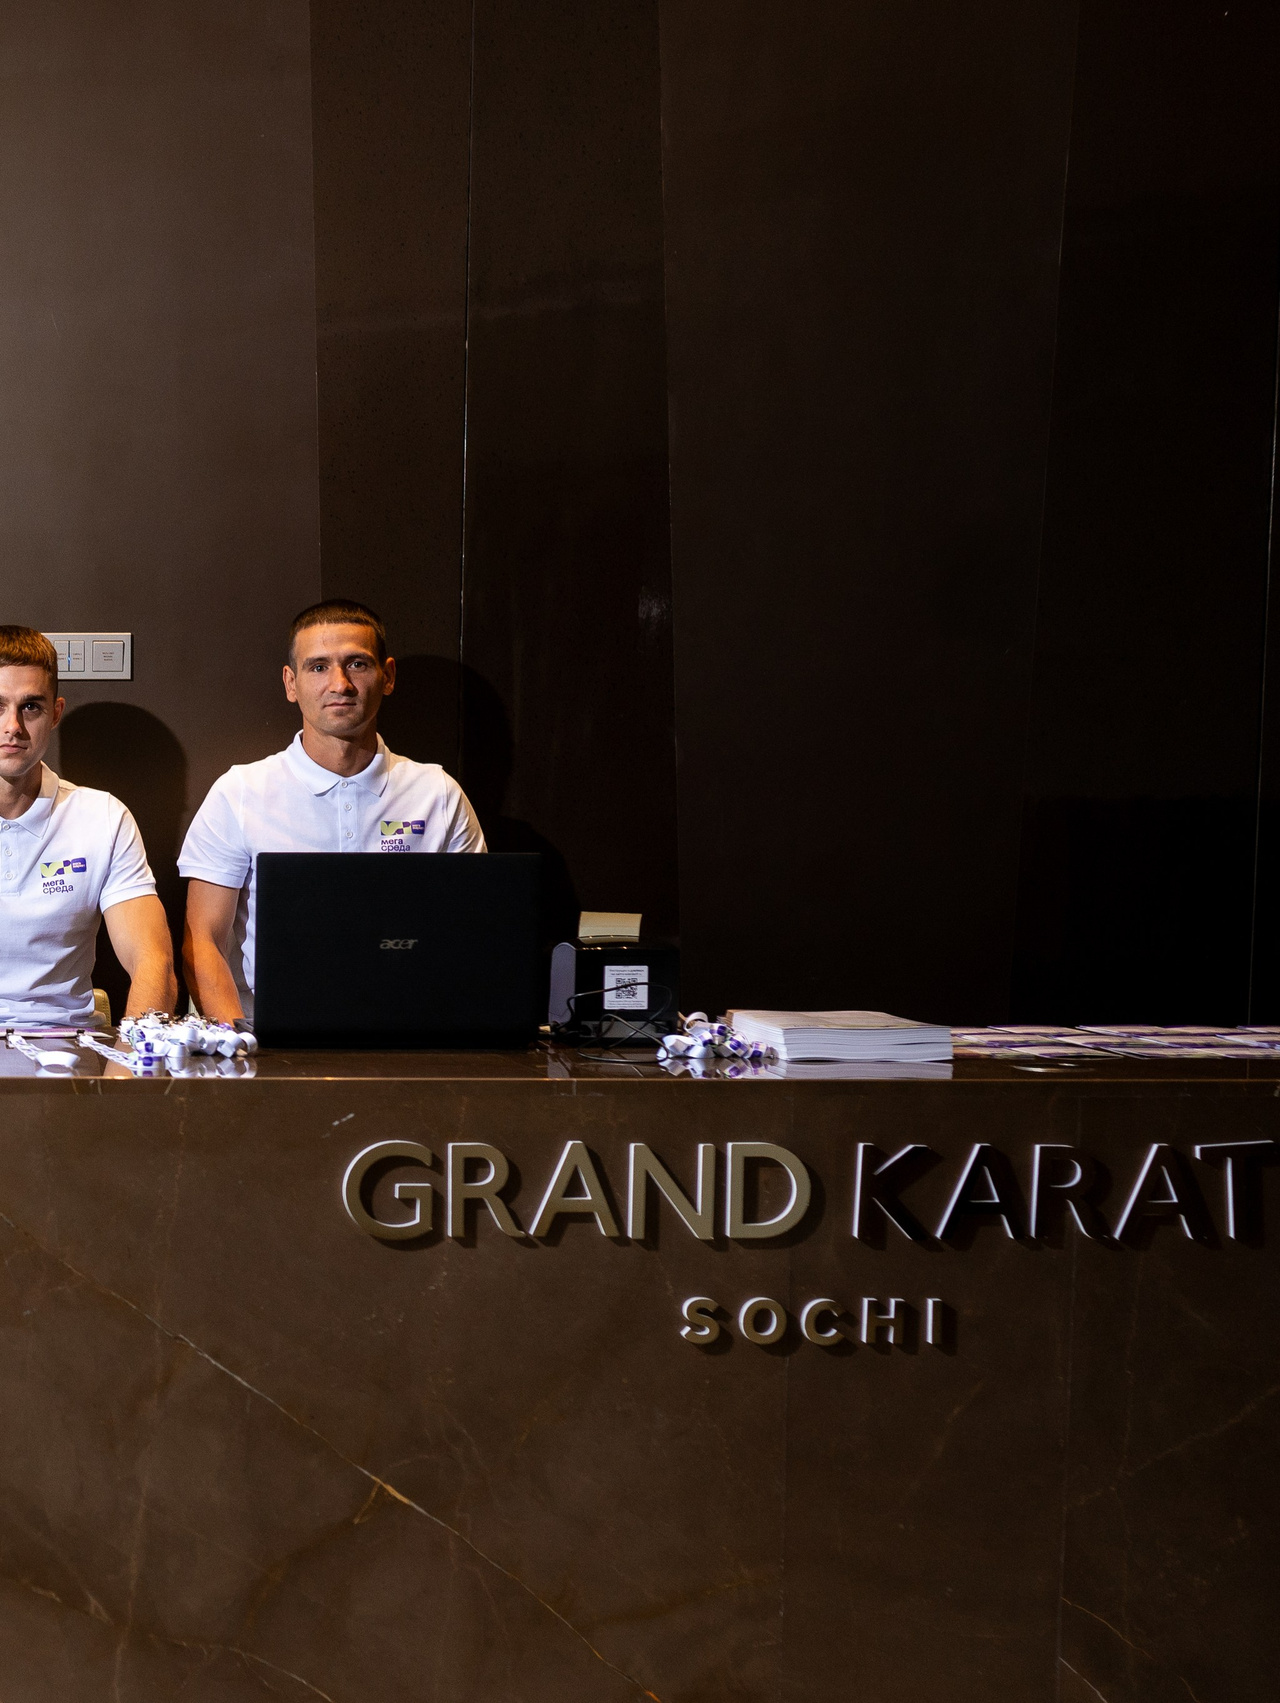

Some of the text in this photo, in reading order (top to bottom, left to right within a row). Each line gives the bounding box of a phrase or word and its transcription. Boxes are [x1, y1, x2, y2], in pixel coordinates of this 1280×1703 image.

[381, 838, 404, 846] мега
[42, 878, 66, 888] мега
[42, 884, 75, 895] среда
[379, 939, 419, 950] acer
[341, 1139, 1276, 1243] GRAND KARAT
[680, 1296, 944, 1346] SOCHI
